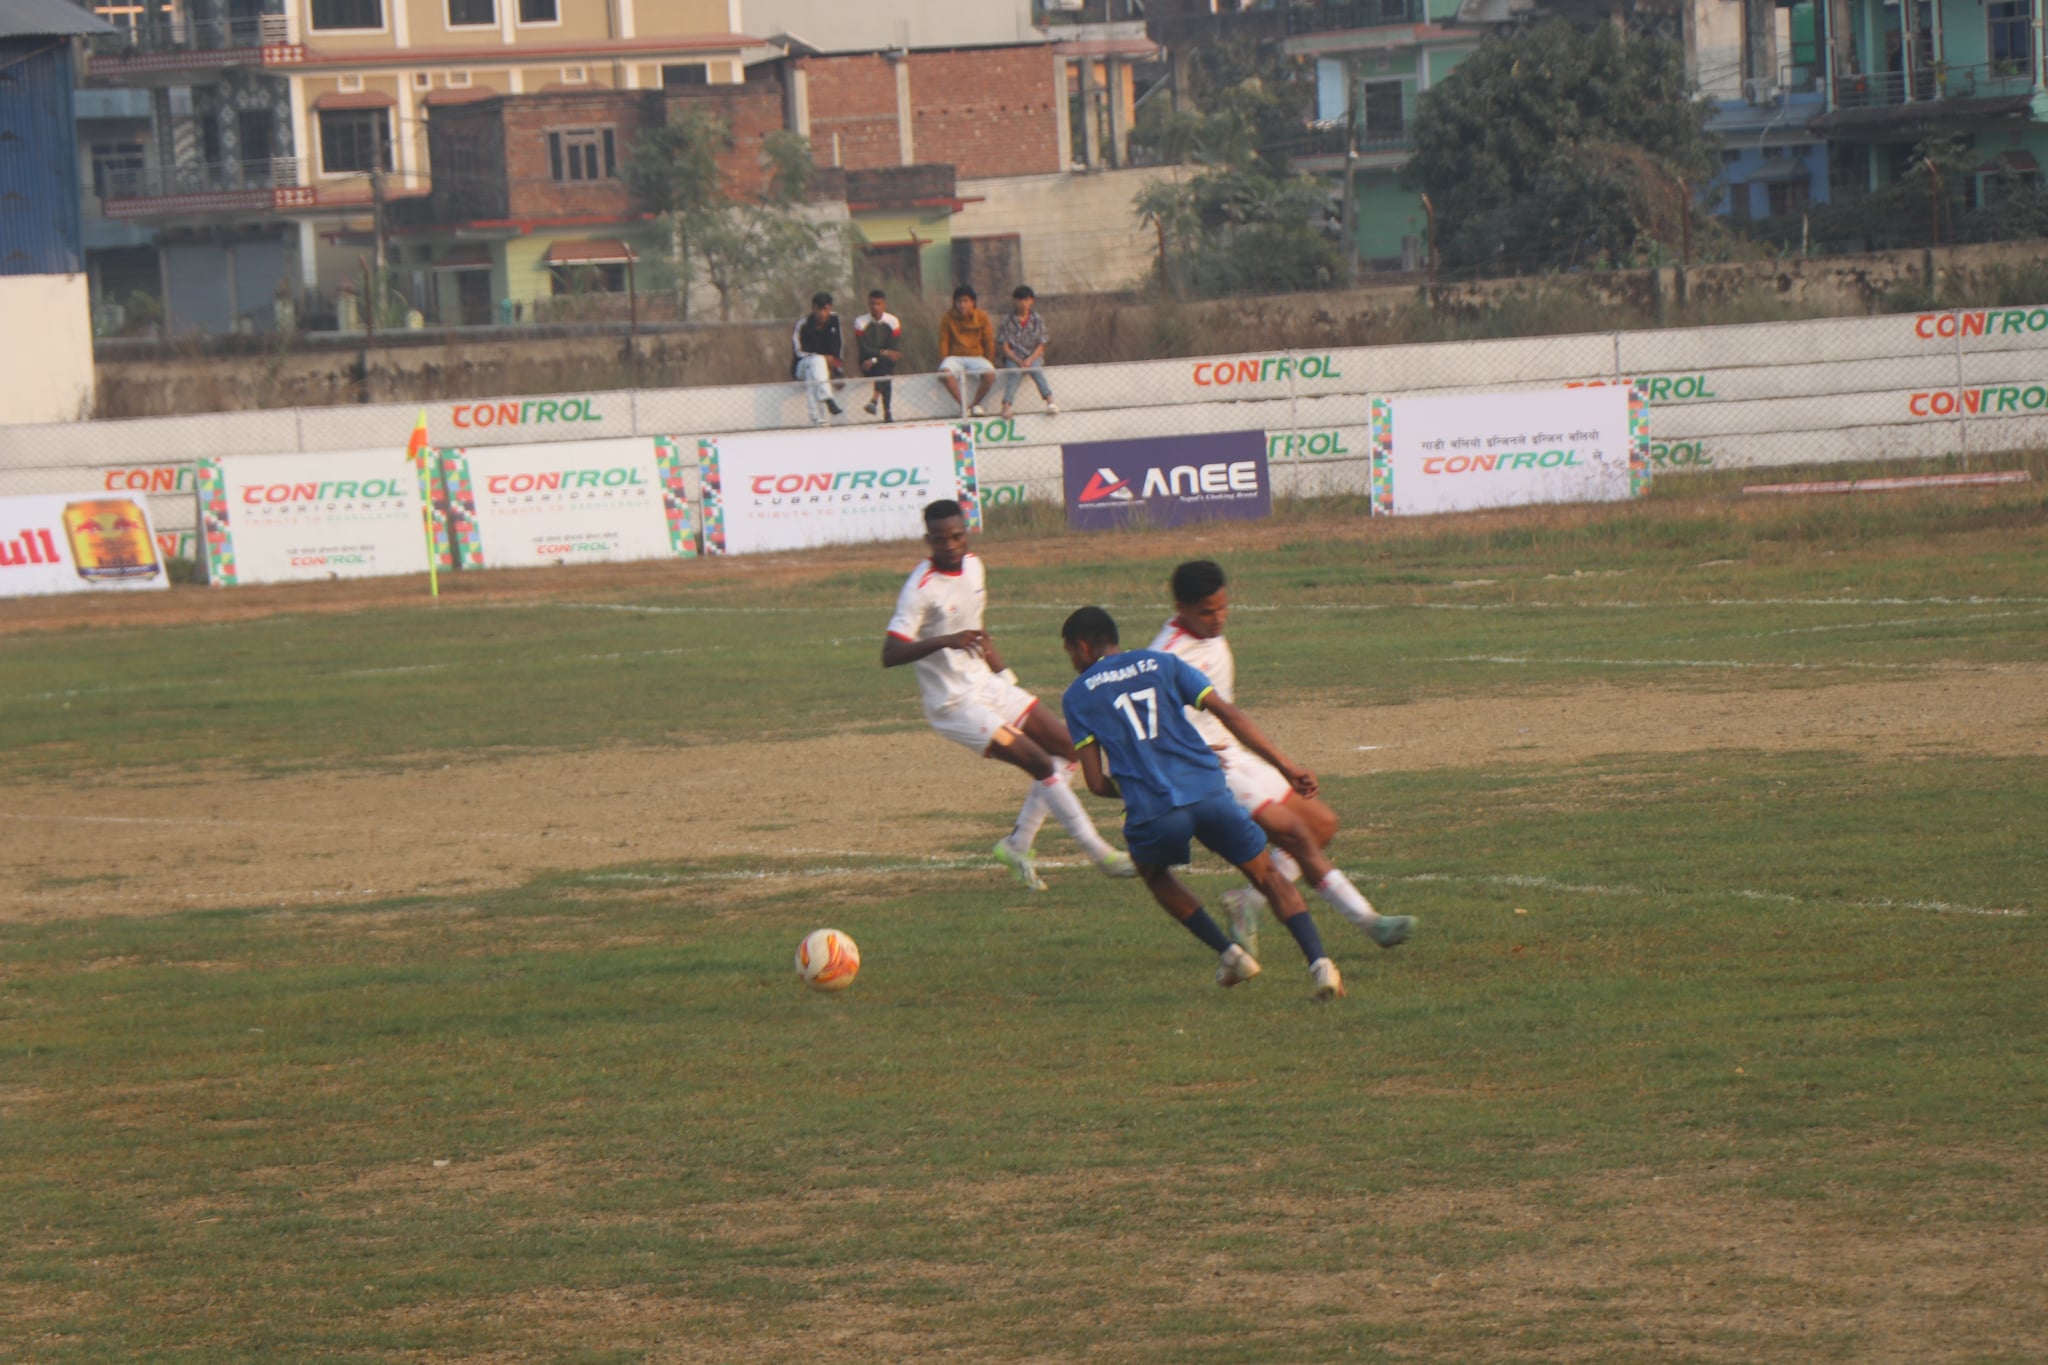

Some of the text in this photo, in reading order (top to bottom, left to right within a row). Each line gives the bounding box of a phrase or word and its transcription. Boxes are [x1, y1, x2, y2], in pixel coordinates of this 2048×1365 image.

[1193, 355, 1341, 386] CONTROL
[452, 398, 602, 428] CONTROL
[1908, 385, 2048, 416] CONTRO
[1267, 431, 1348, 458] TROL
[1421, 449, 1584, 474] CONTROL
[105, 467, 196, 492] CONT
[239, 478, 407, 504] CONTROL
[486, 467, 647, 494] CONTROL
[749, 467, 929, 494] CONTROL
[1142, 461, 1258, 498] ANEE
[246, 500, 404, 515] LUBRICANTS
[491, 489, 646, 504] LUBRICANTS
[753, 489, 927, 505] LUBRICANTS
[1084, 664, 1138, 690] DHARAN
[1113, 687, 1158, 741] 17
